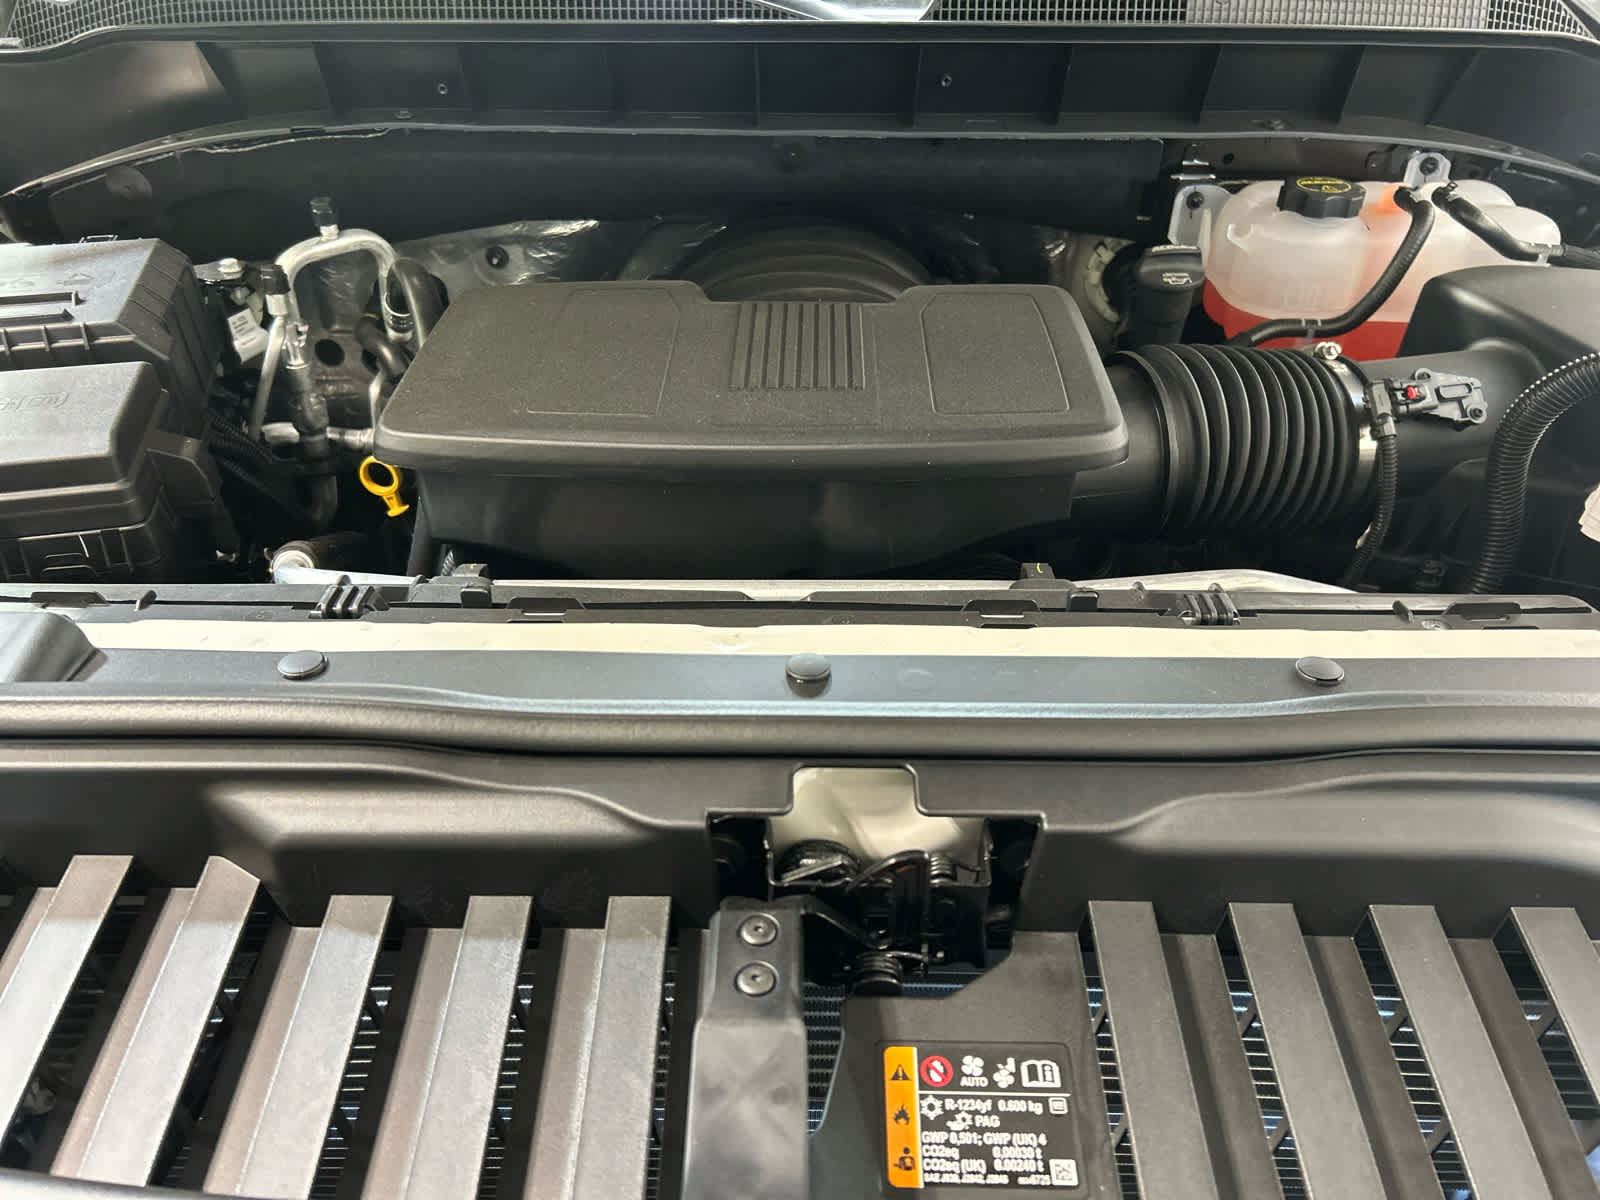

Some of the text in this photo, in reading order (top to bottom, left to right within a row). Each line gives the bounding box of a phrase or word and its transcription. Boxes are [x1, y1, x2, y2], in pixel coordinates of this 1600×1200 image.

[960, 1076, 988, 1087] AUTO
[945, 1099, 992, 1113] R-1234yf
[1028, 1100, 1043, 1114] kg
[975, 1115, 1000, 1127] PAG
[922, 1131, 948, 1143] GWP
[983, 1132, 1011, 1144] GWP
[1013, 1133, 1037, 1147] (UK)
[1039, 1133, 1047, 1145] 4
[924, 1158, 960, 1173] CO2eq
[961, 1159, 987, 1174] (UK)
